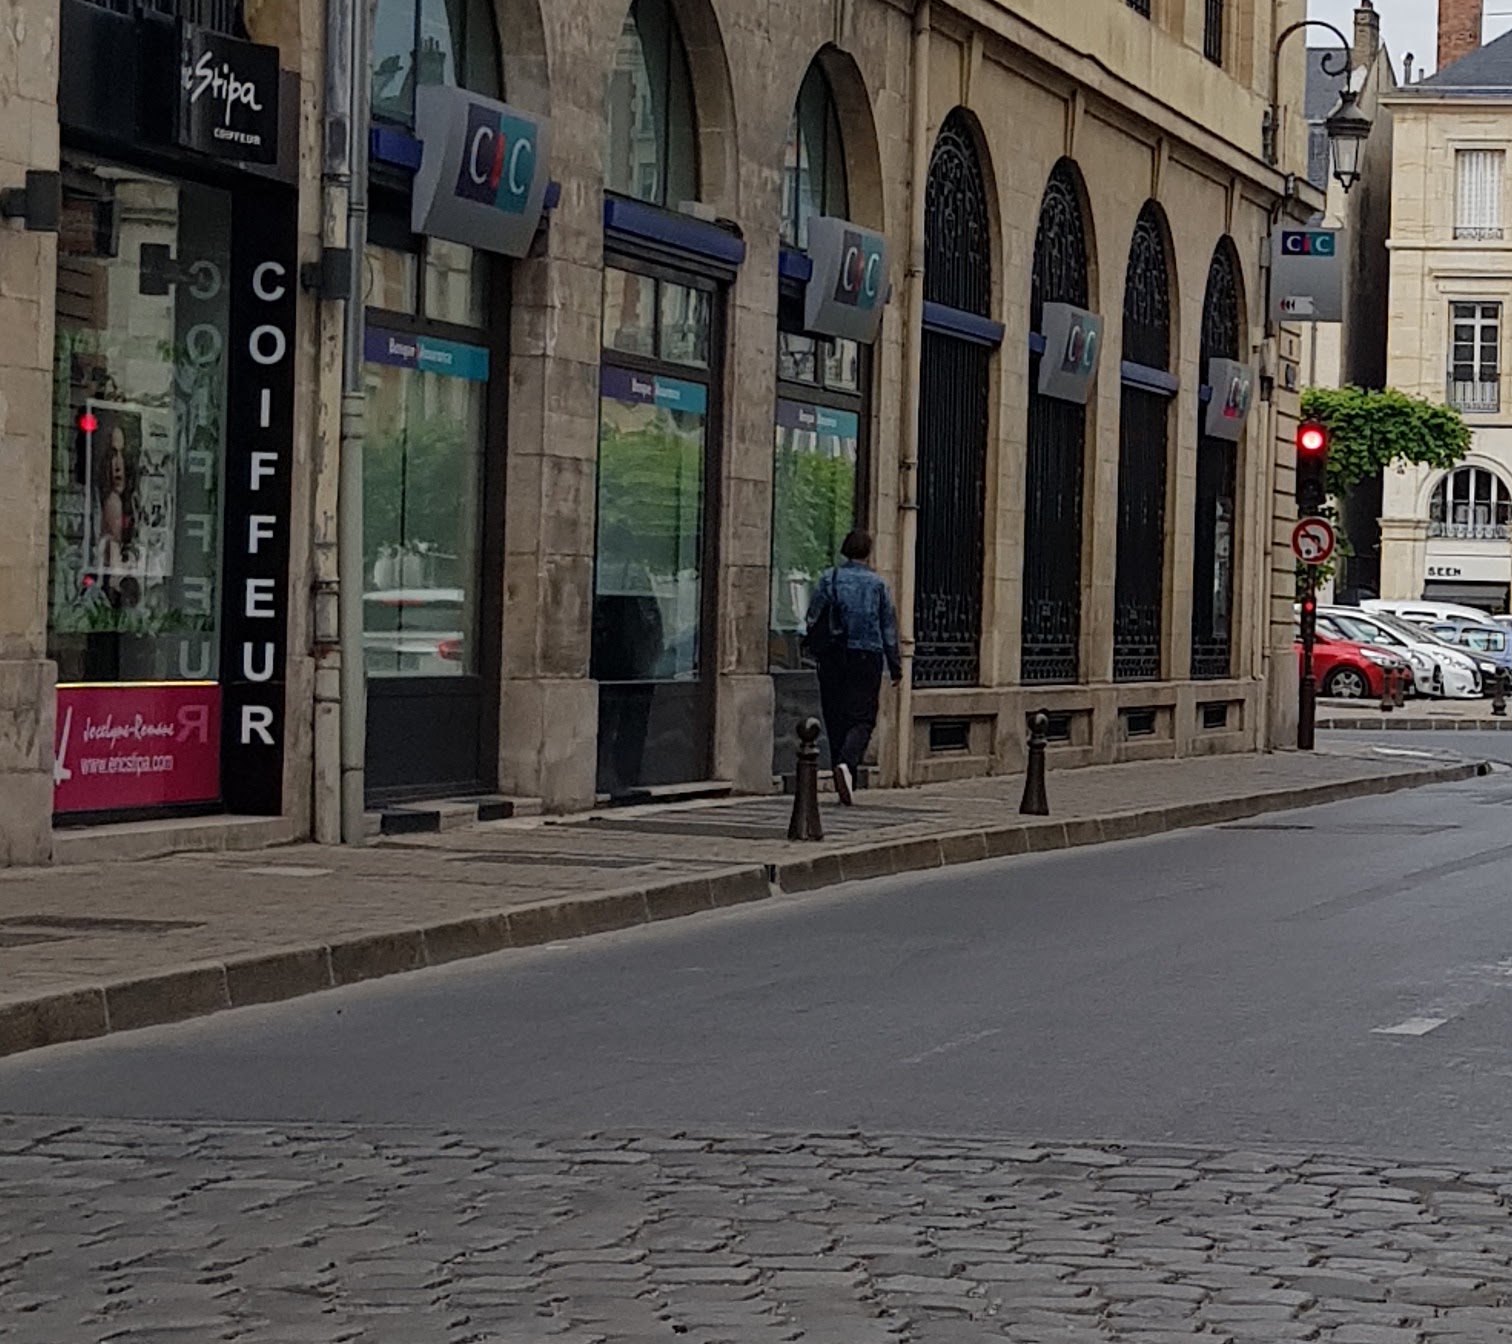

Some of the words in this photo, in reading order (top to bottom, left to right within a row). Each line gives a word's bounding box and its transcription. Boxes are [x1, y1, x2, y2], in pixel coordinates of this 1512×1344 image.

[191, 51, 263, 127] Stipa
[470, 126, 532, 195] CIC
[1286, 236, 1331, 253] CIC
[843, 246, 879, 296] CIC
[1069, 325, 1096, 366] CIC
[240, 260, 287, 746] COIFFEUR
[1428, 567, 1461, 577] SEEN
